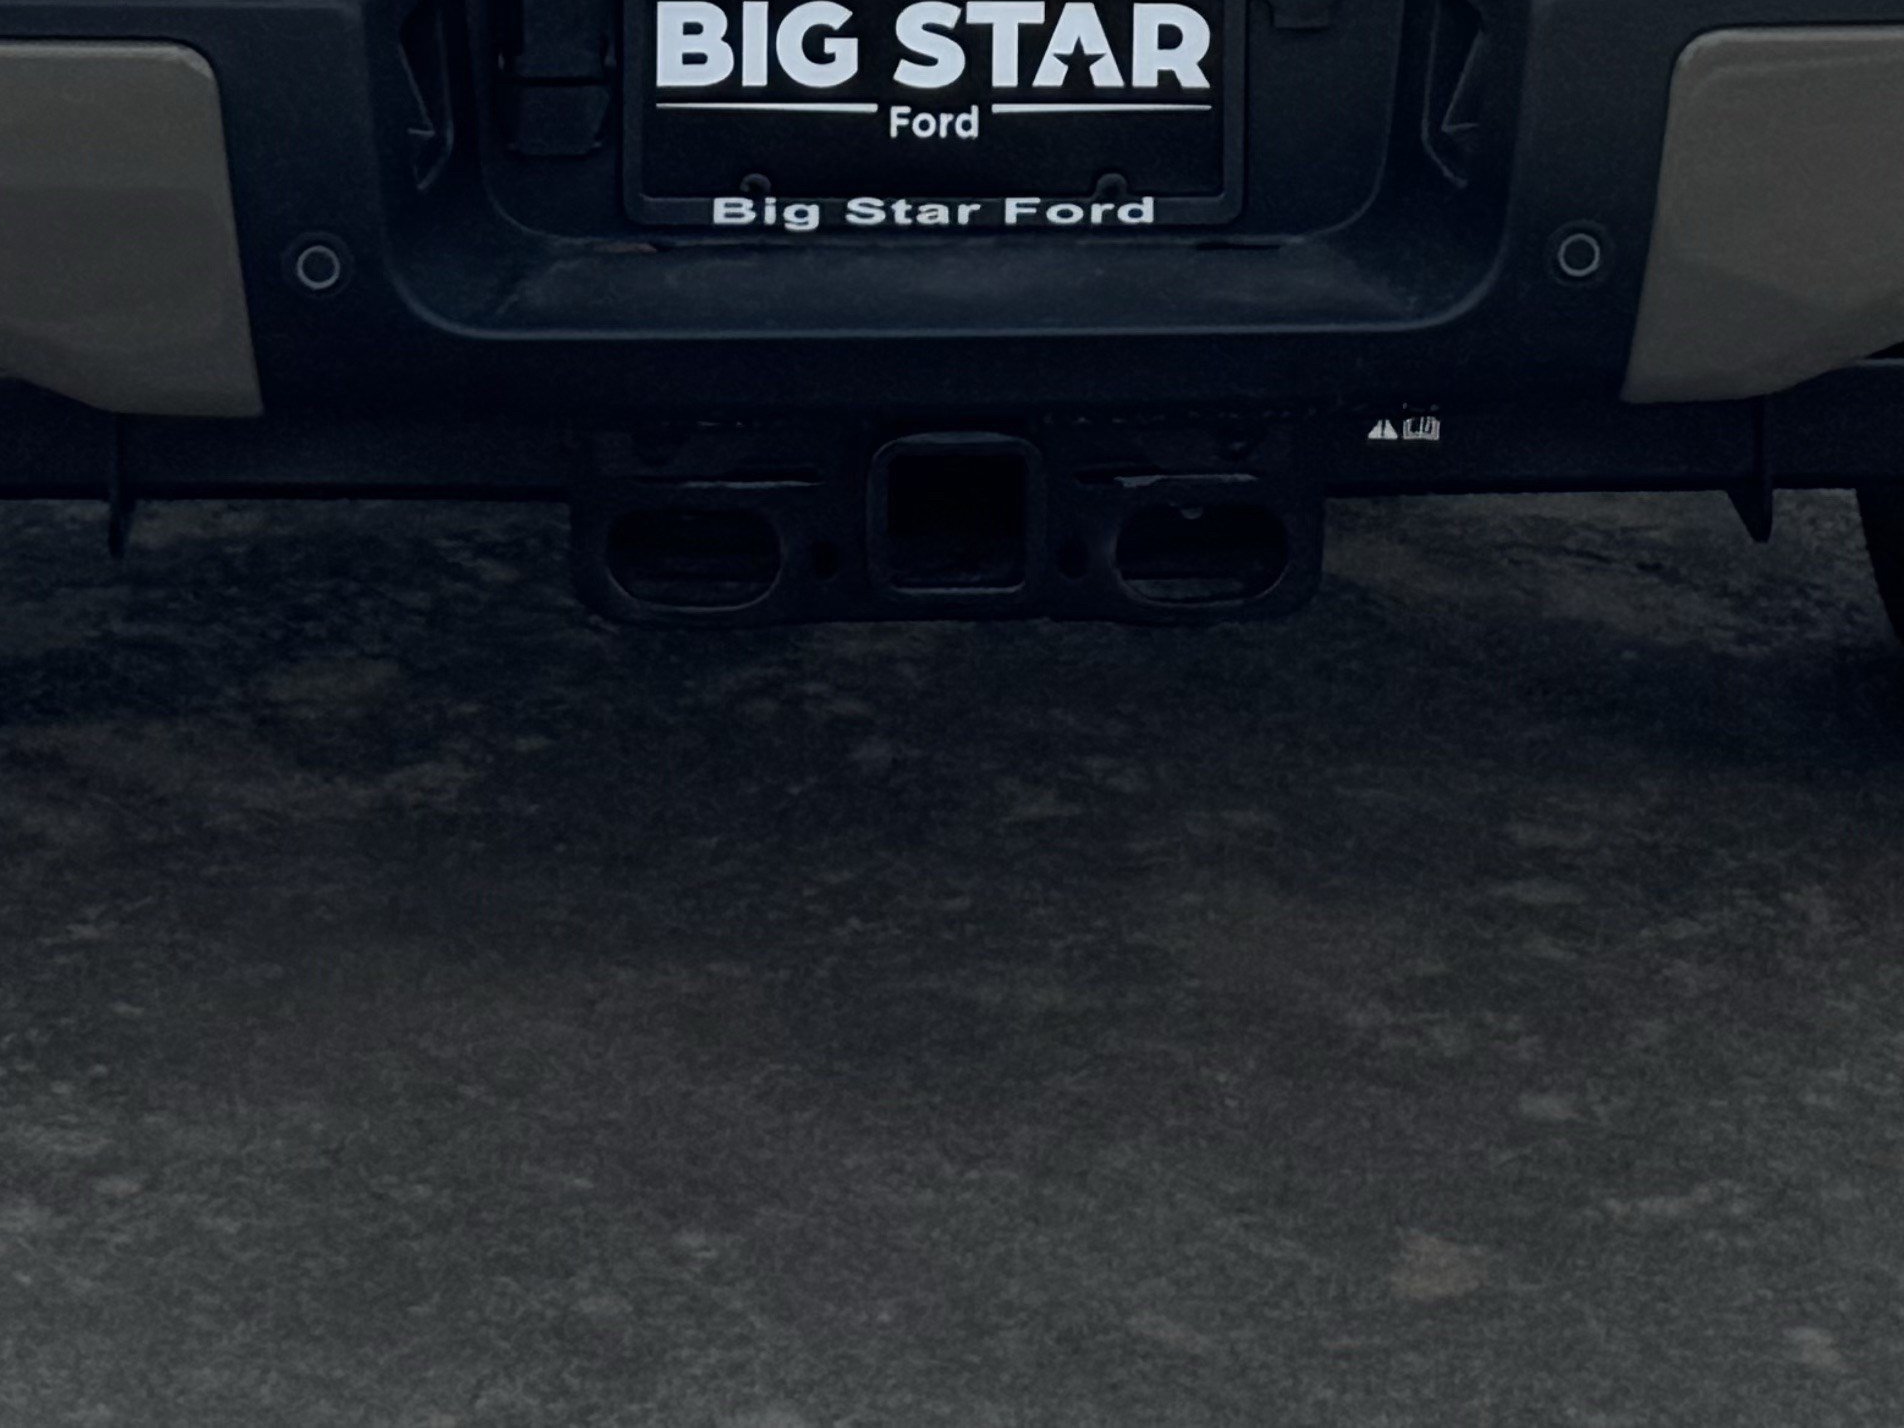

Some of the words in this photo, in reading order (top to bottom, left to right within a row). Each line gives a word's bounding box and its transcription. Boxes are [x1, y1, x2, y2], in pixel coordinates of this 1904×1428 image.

[656, 1, 858, 88] BIG
[893, 1, 1211, 88] STAR
[890, 105, 979, 138] Ford
[713, 197, 820, 231] Big
[845, 197, 981, 225] Star
[1003, 197, 1154, 224] Ford
